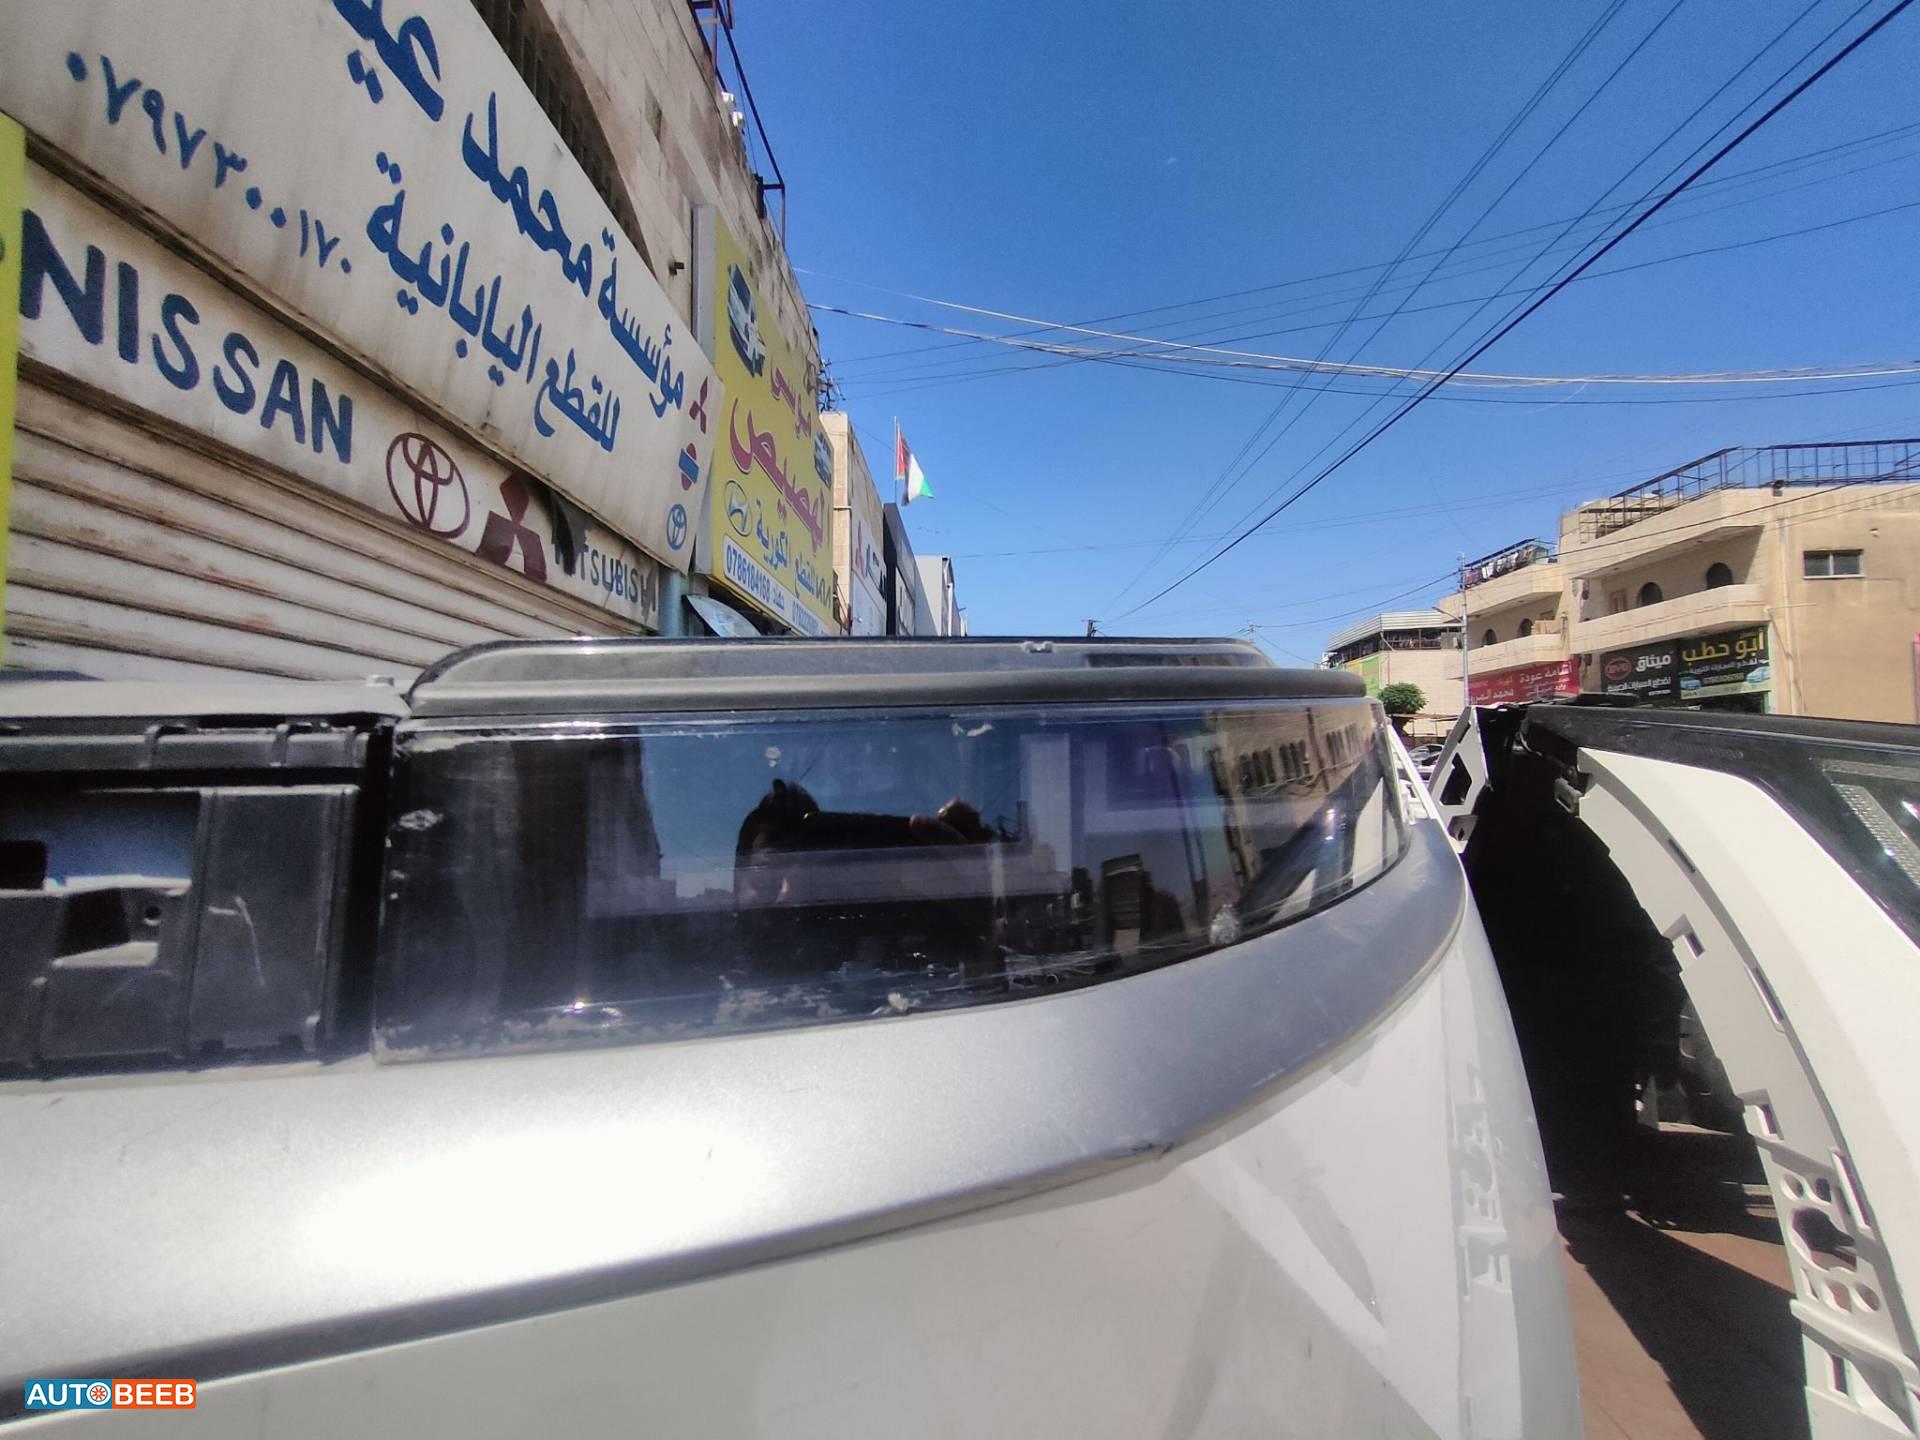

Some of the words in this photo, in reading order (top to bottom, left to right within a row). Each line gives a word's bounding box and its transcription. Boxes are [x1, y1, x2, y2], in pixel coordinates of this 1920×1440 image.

[19, 208, 352, 463] NISSAN
[366, 151, 542, 386] اليابانية
[598, 226, 684, 418] مؤسسة
[534, 348, 621, 452] للقطع
[1682, 640, 1730, 666] حطب
